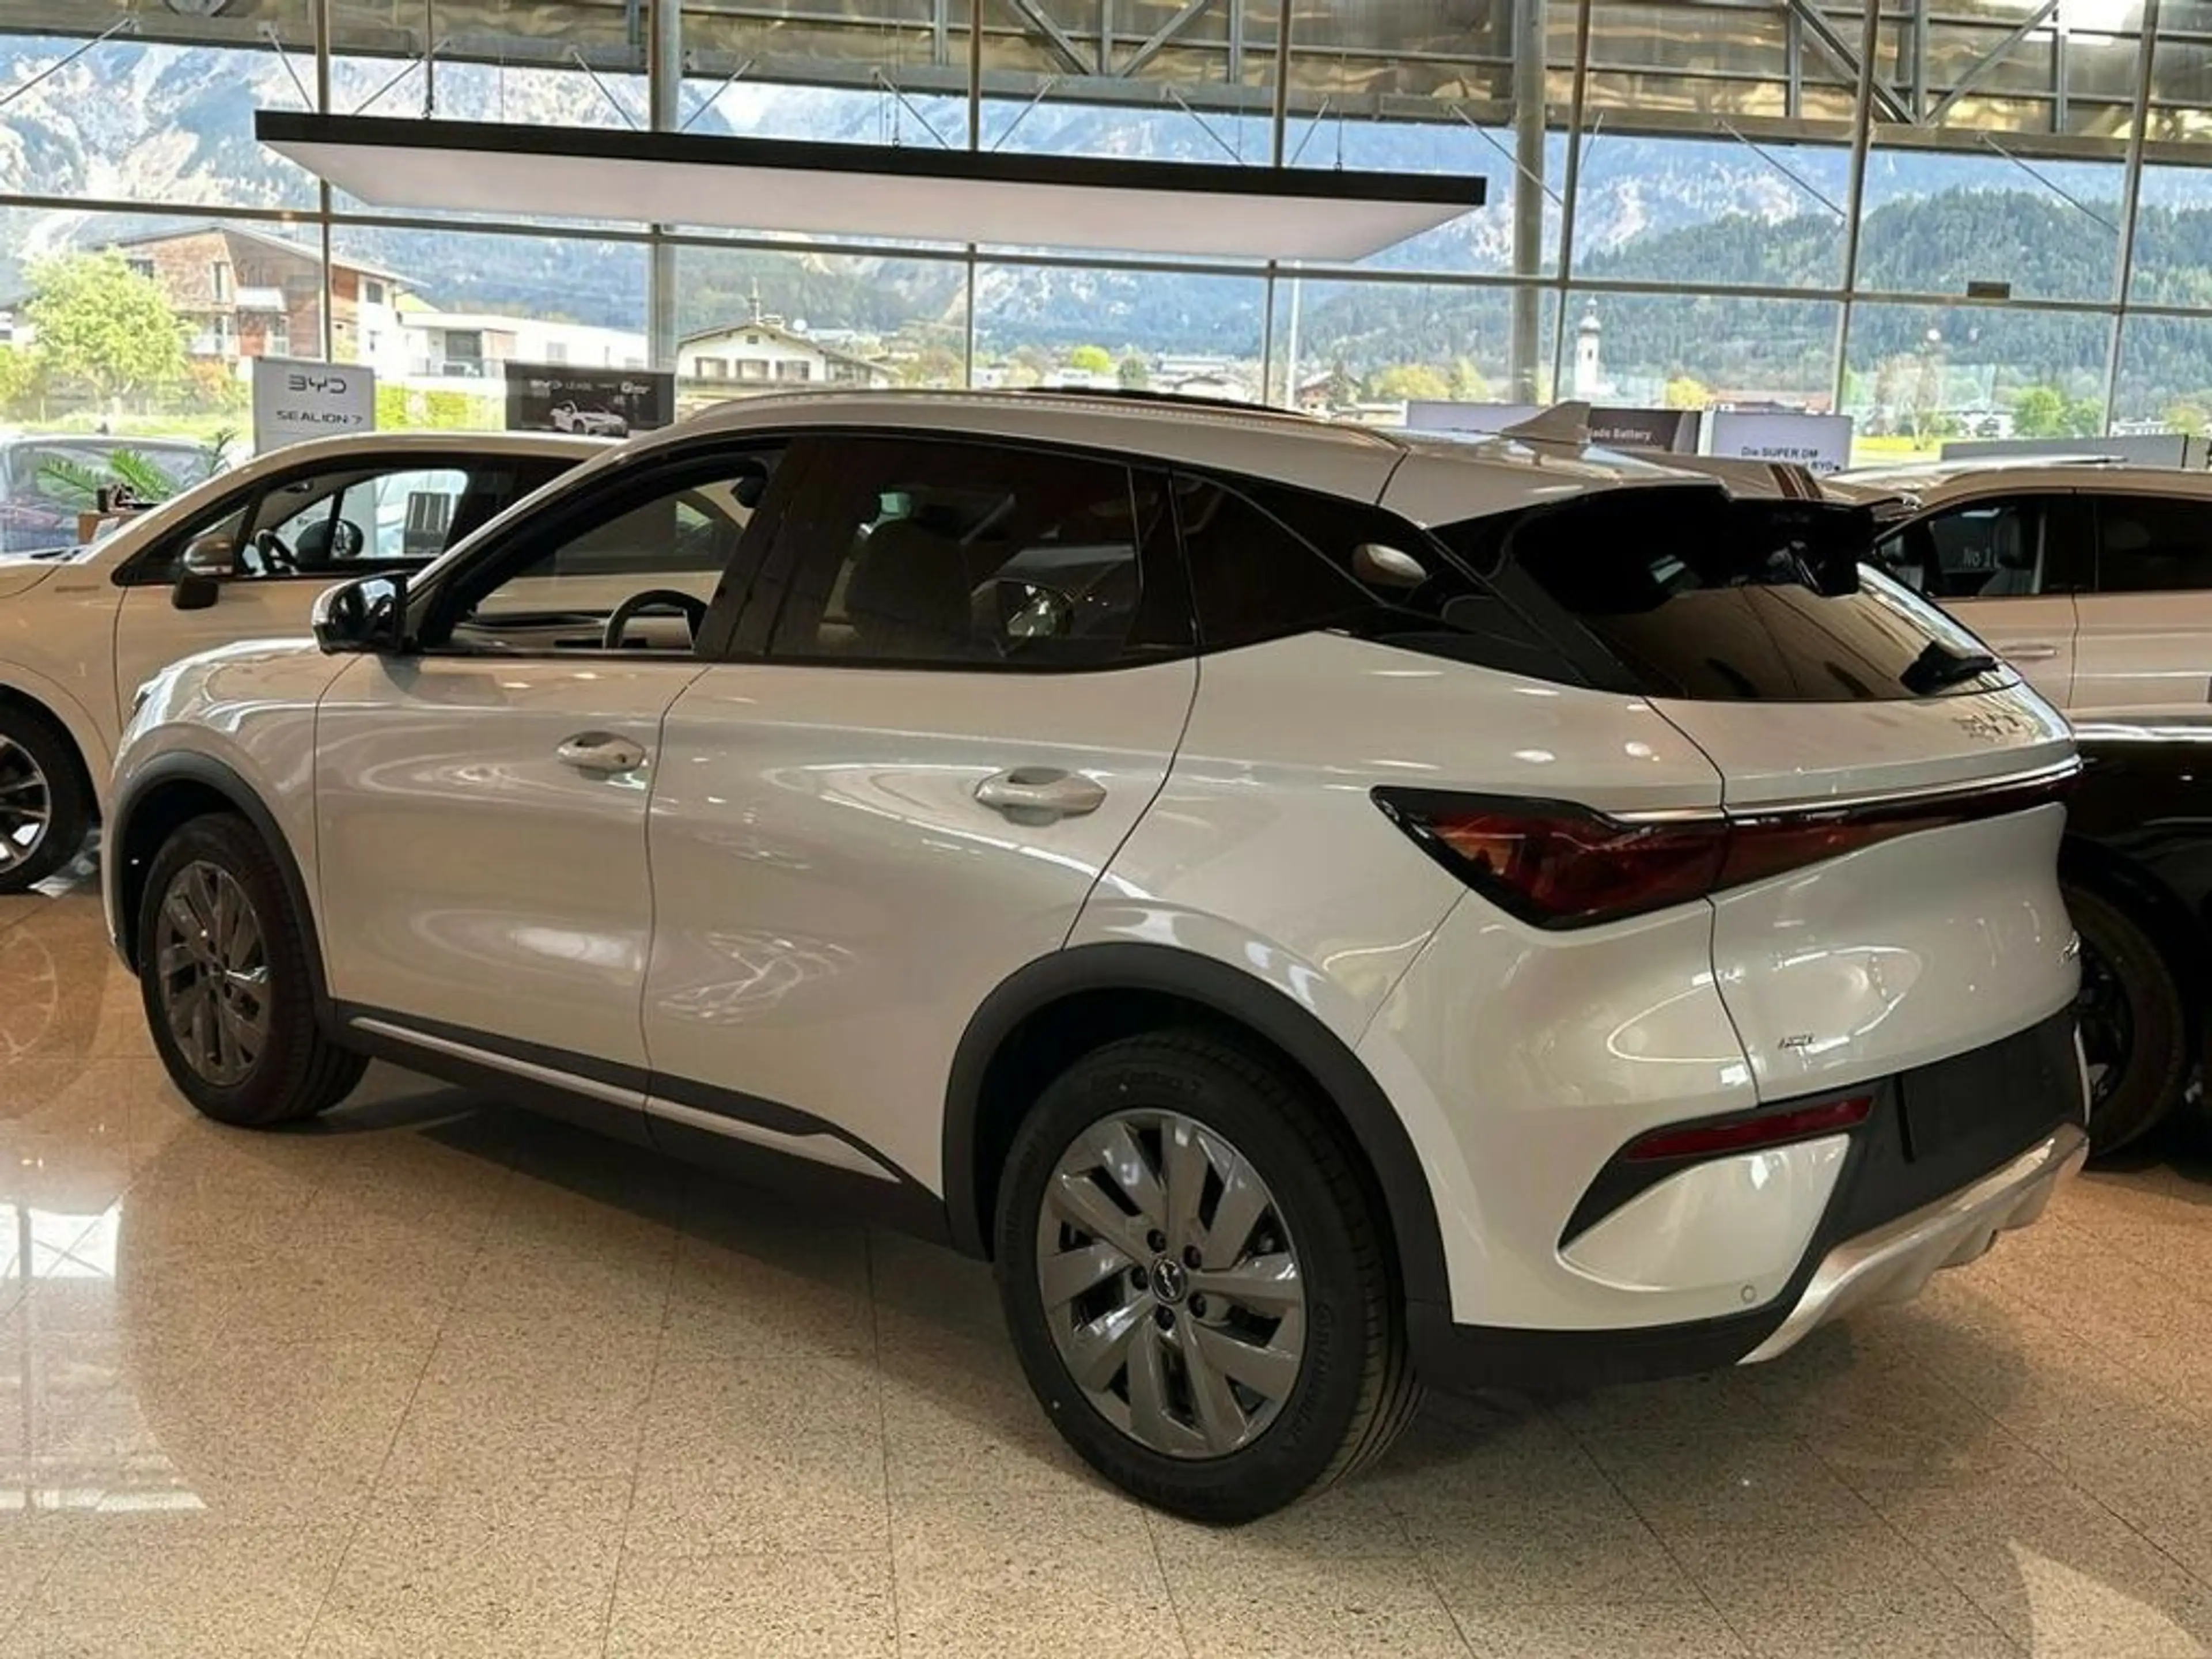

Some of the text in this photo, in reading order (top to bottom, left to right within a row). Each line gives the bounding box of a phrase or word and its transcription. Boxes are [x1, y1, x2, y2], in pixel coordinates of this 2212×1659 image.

[289, 374, 346, 394] BYD
[276, 411, 363, 425] SEALION 7
[1613, 427, 1653, 444] Battery
[1762, 448, 1799, 459] SUPER
